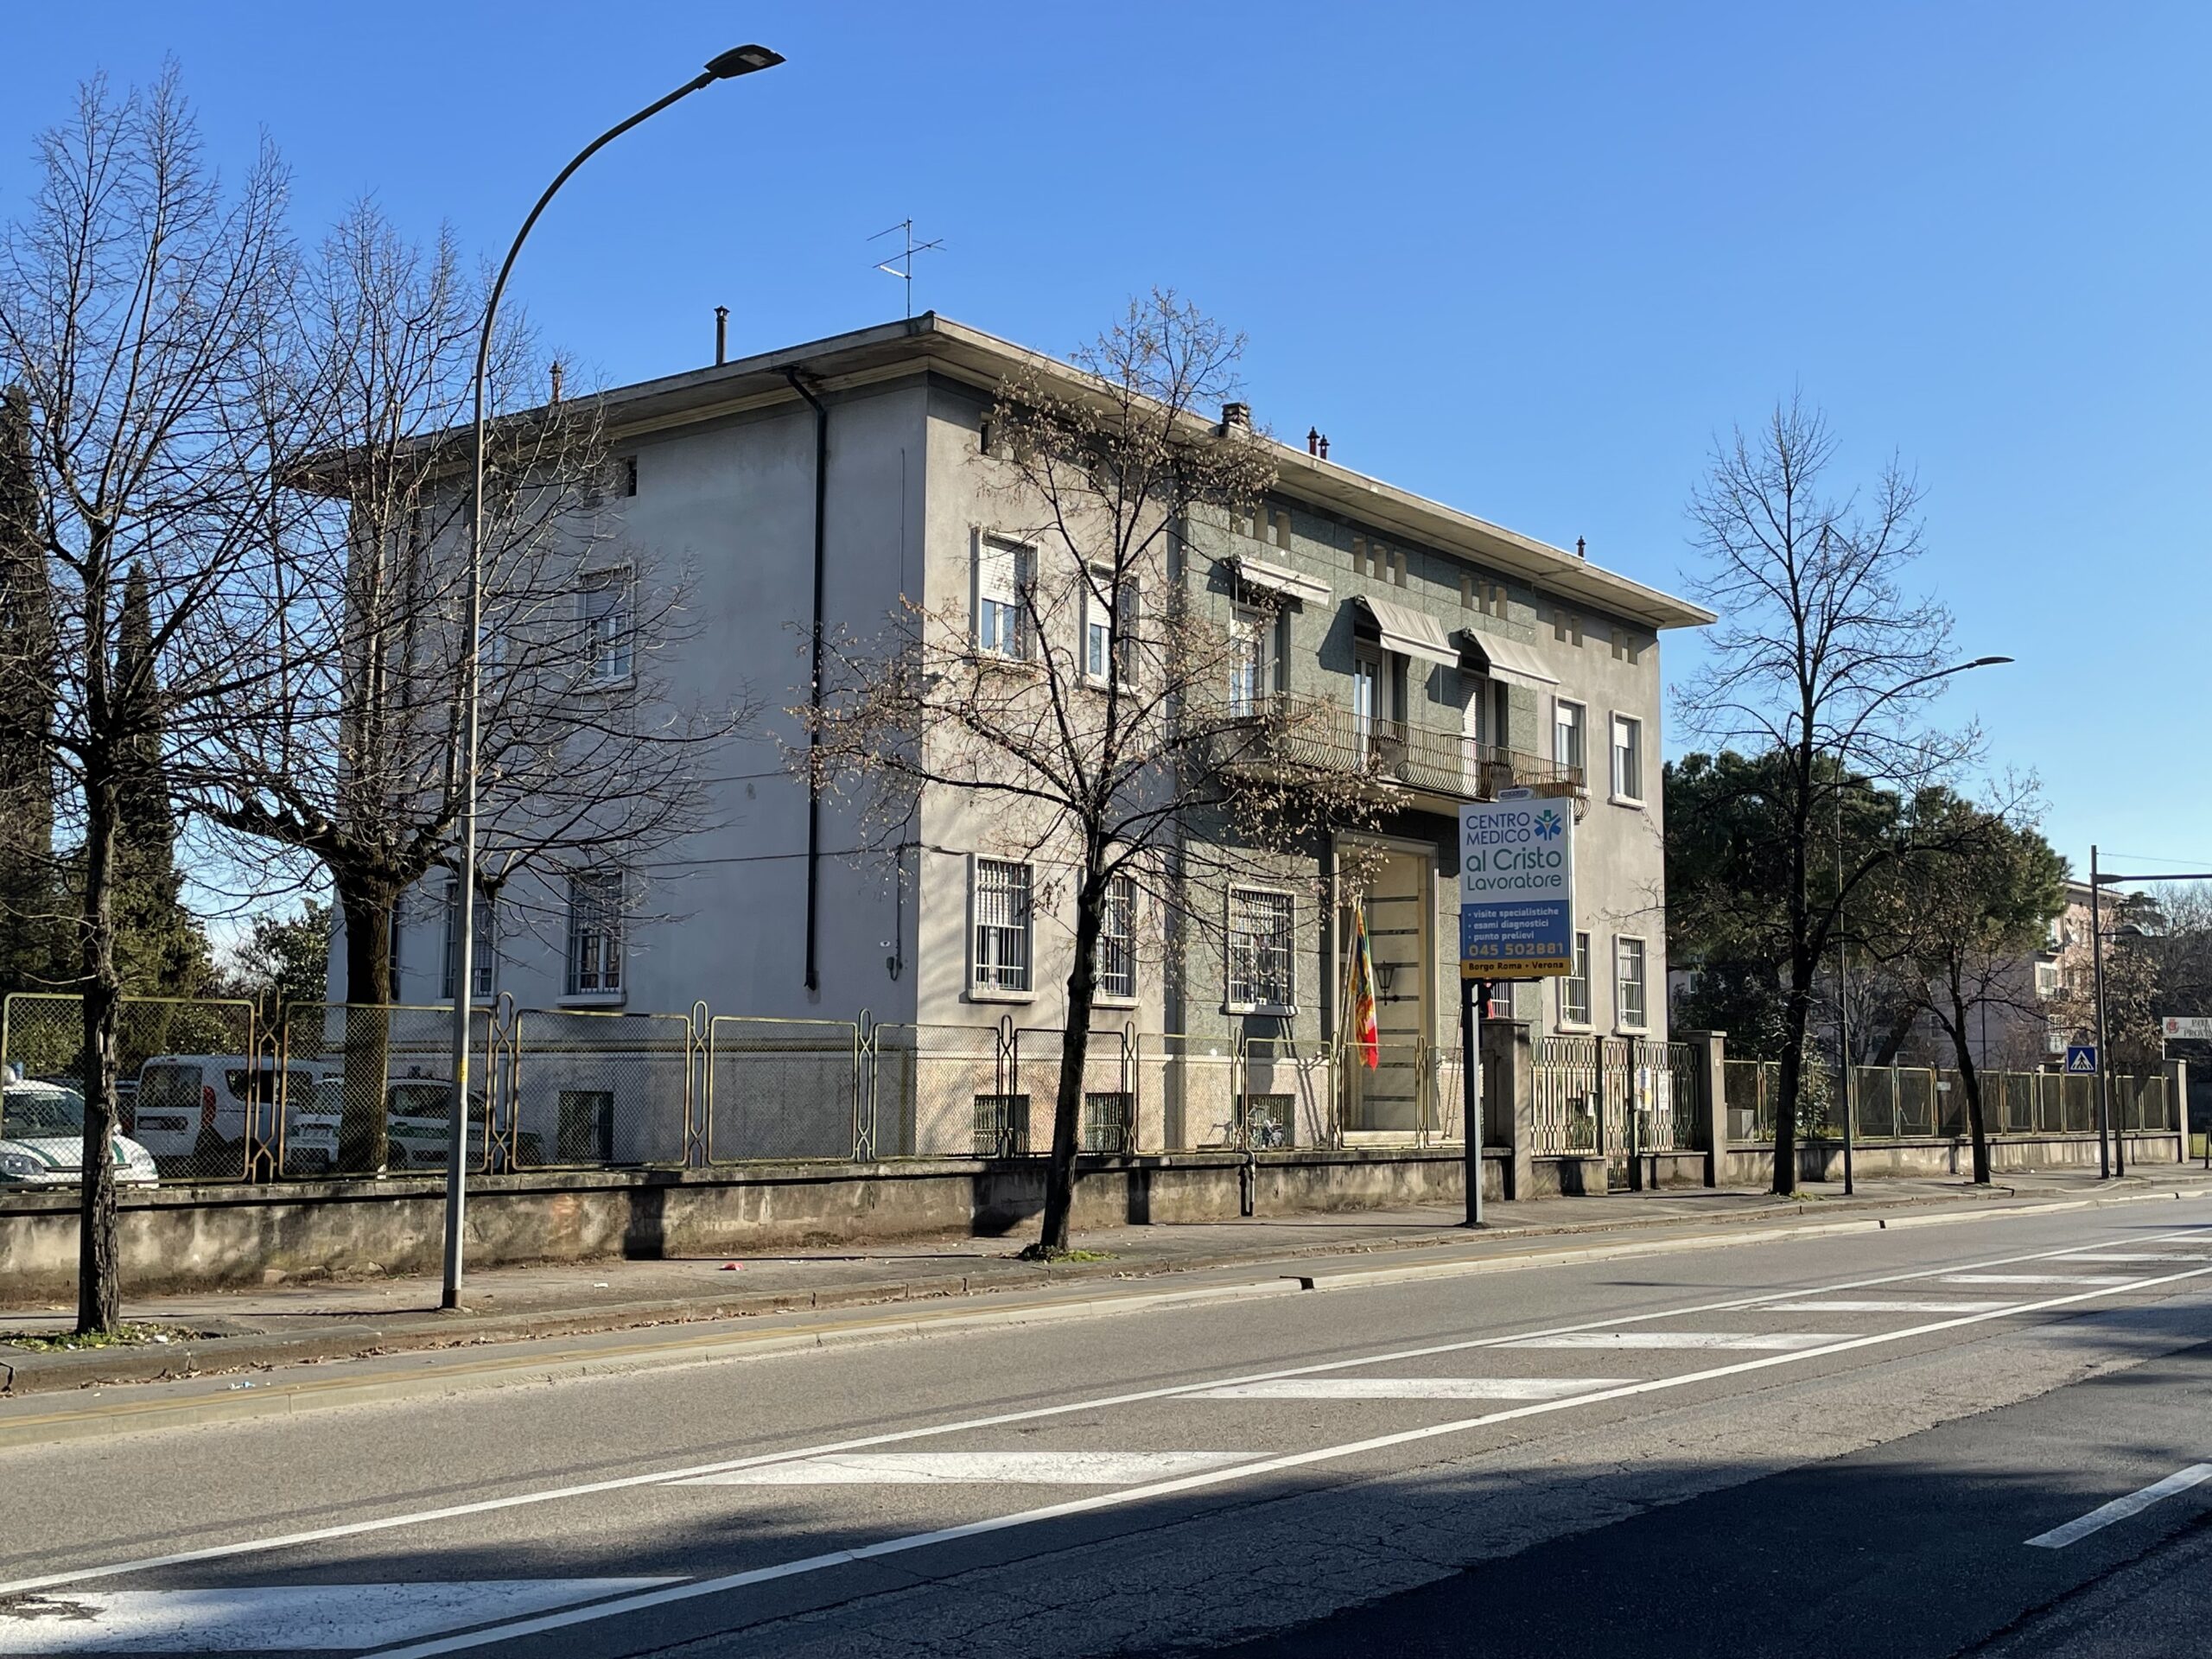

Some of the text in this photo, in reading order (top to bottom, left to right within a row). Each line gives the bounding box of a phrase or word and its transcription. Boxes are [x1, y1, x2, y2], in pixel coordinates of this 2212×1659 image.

[1466, 812, 1530, 830] CENTRO
[1466, 829, 1530, 845] MEDICO
[1466, 847, 1562, 872] al Cristo
[1467, 872, 1561, 890] Lavoratore
[1499, 907, 1559, 918] specialistiche
[1501, 919, 1548, 930] diagnostici
[1474, 931, 1534, 942] punto prelievi
[1469, 943, 1563, 956] 045 502881
[1469, 963, 1494, 971] Borgo
